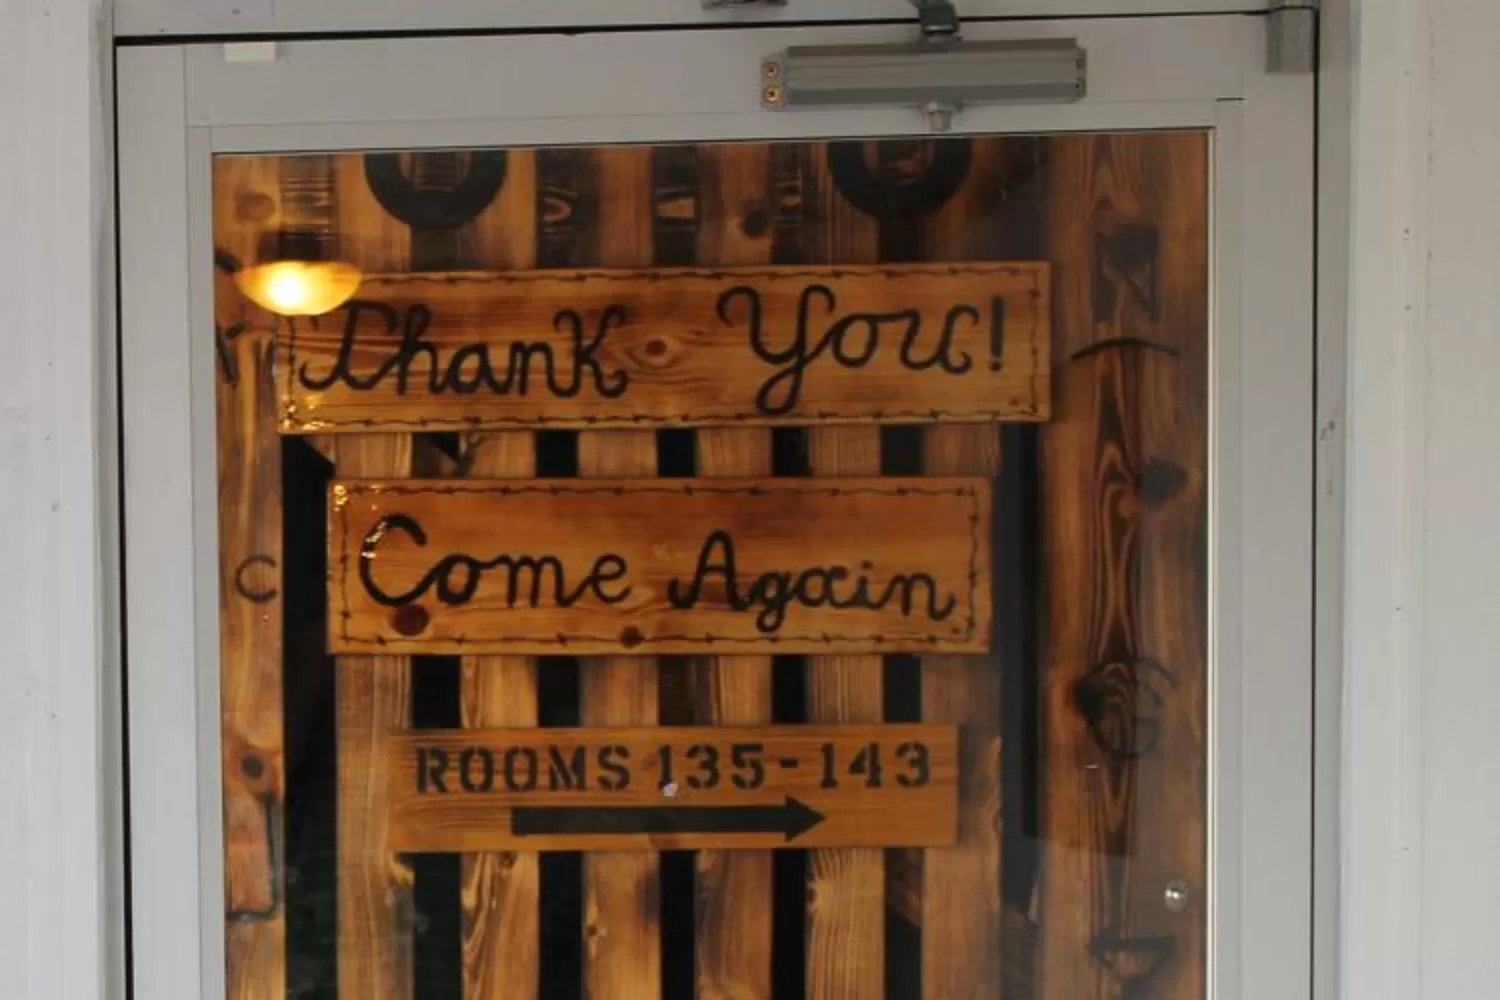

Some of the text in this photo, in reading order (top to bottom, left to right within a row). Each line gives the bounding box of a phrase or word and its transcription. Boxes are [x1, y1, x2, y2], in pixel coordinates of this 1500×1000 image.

[715, 284, 1007, 416] You!
[358, 512, 956, 633] Come Again
[414, 744, 631, 794] ROOMS
